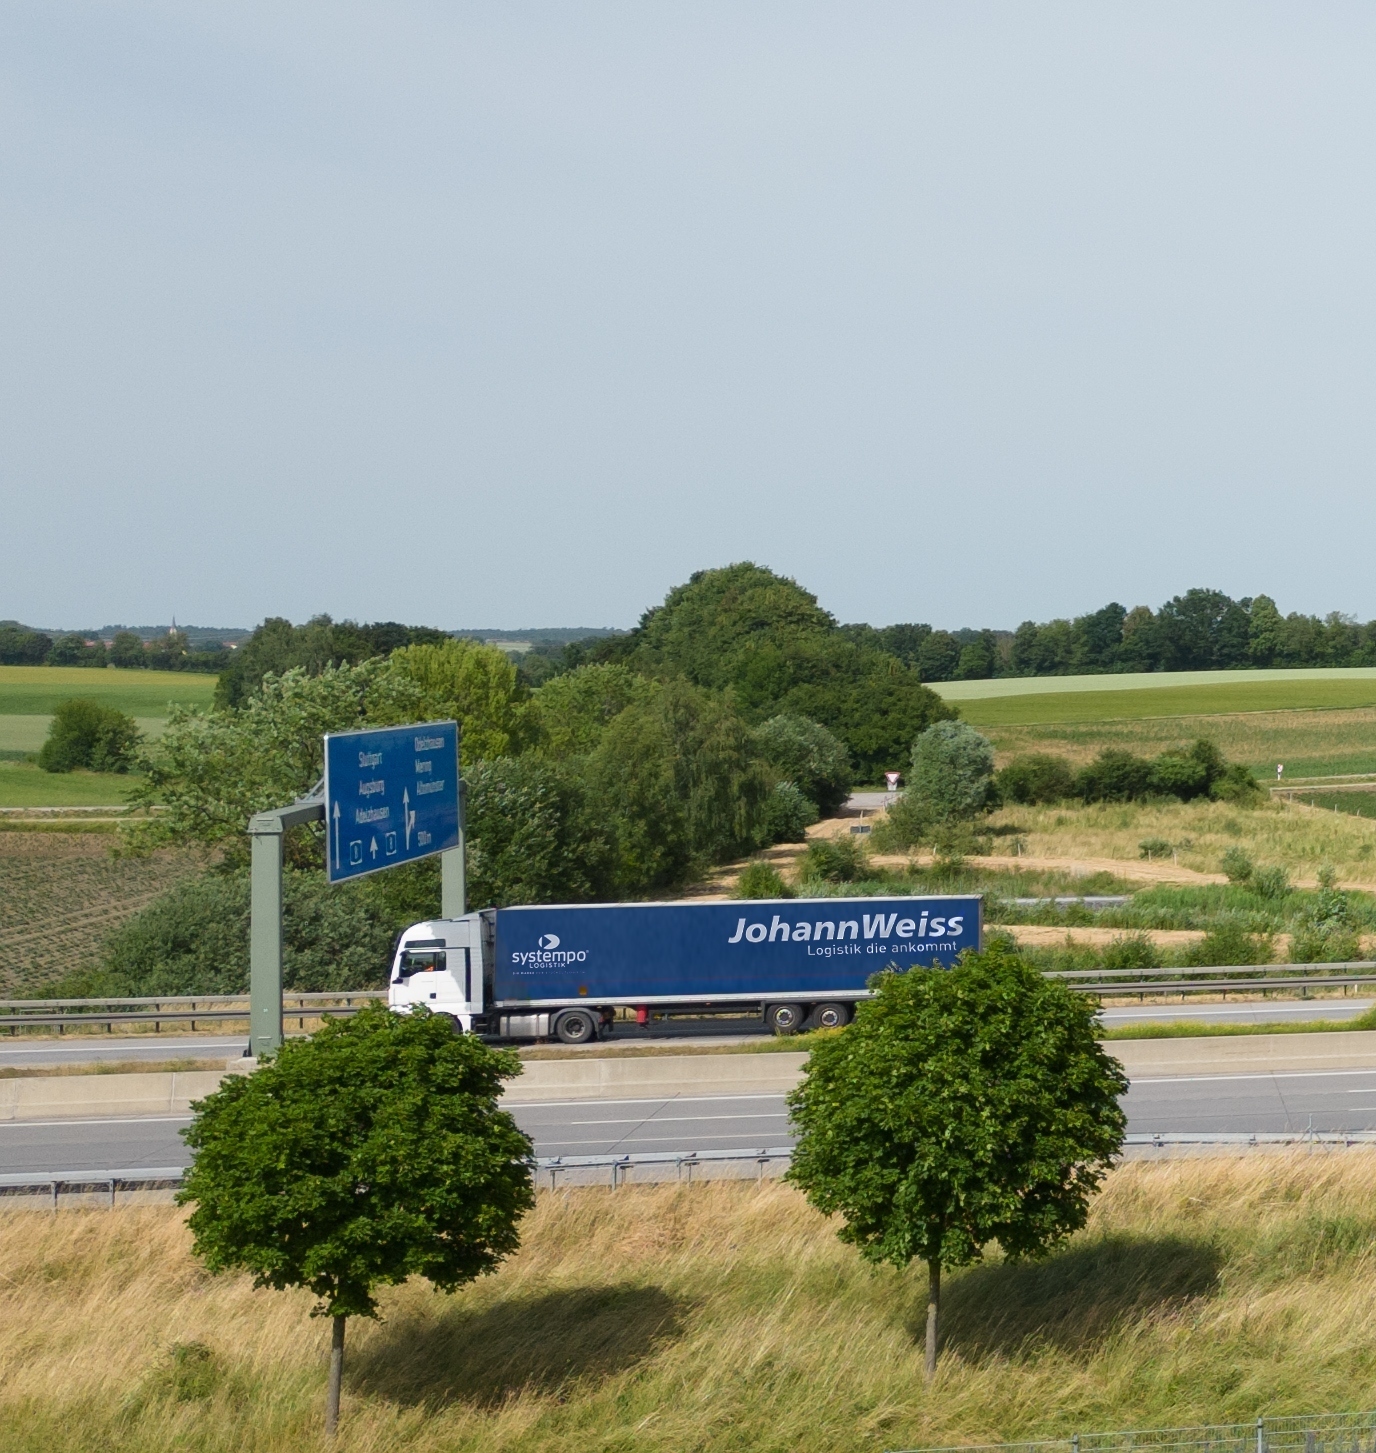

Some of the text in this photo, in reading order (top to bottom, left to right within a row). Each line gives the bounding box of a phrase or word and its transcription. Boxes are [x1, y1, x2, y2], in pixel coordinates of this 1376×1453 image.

[358, 751, 383, 770] Stuttgart
[358, 778, 385, 798] Augsburg
[728, 911, 964, 944] JohannWeiss
[511, 949, 587, 966] systempo
[807, 941, 957, 958] Logistik die ankommt
